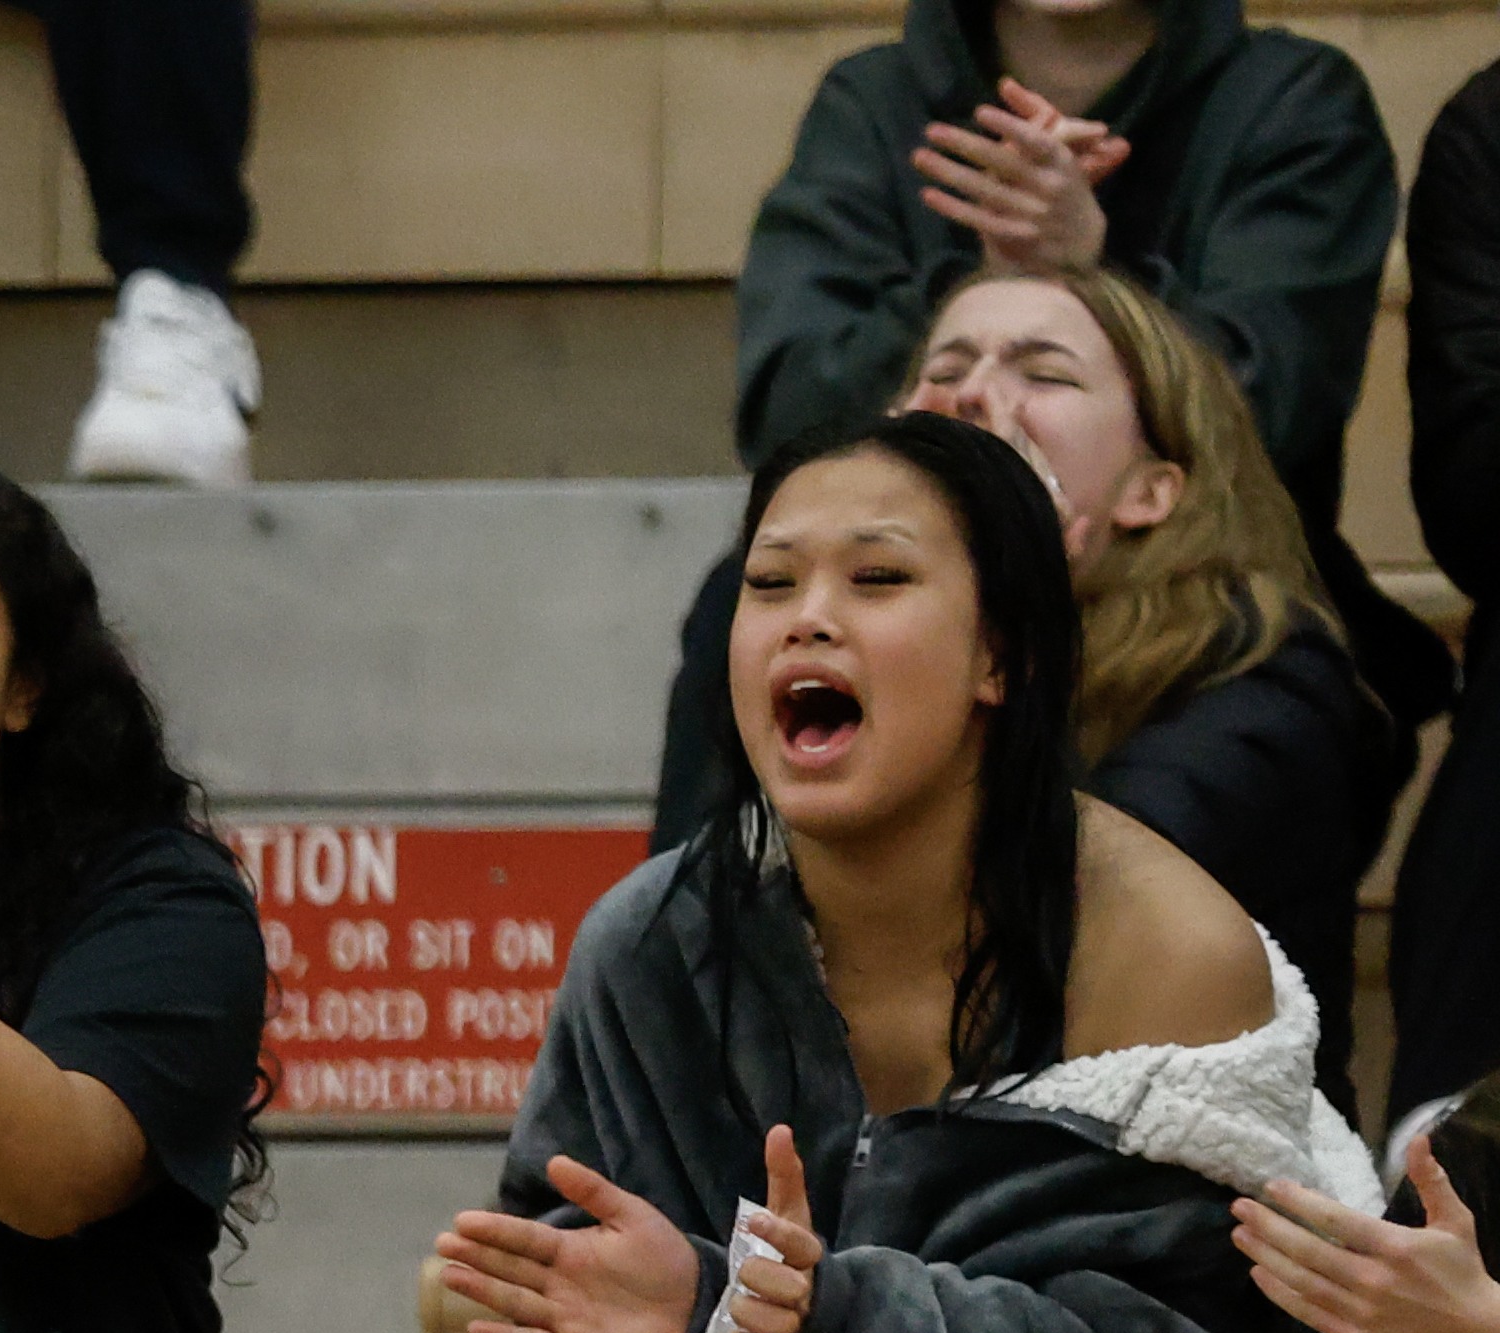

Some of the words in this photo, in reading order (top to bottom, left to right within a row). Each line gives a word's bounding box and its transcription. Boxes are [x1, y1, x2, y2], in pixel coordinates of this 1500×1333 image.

[238, 824, 398, 906] TION
[328, 918, 390, 971] OR
[408, 918, 474, 971] SIT
[494, 918, 555, 971] ON
